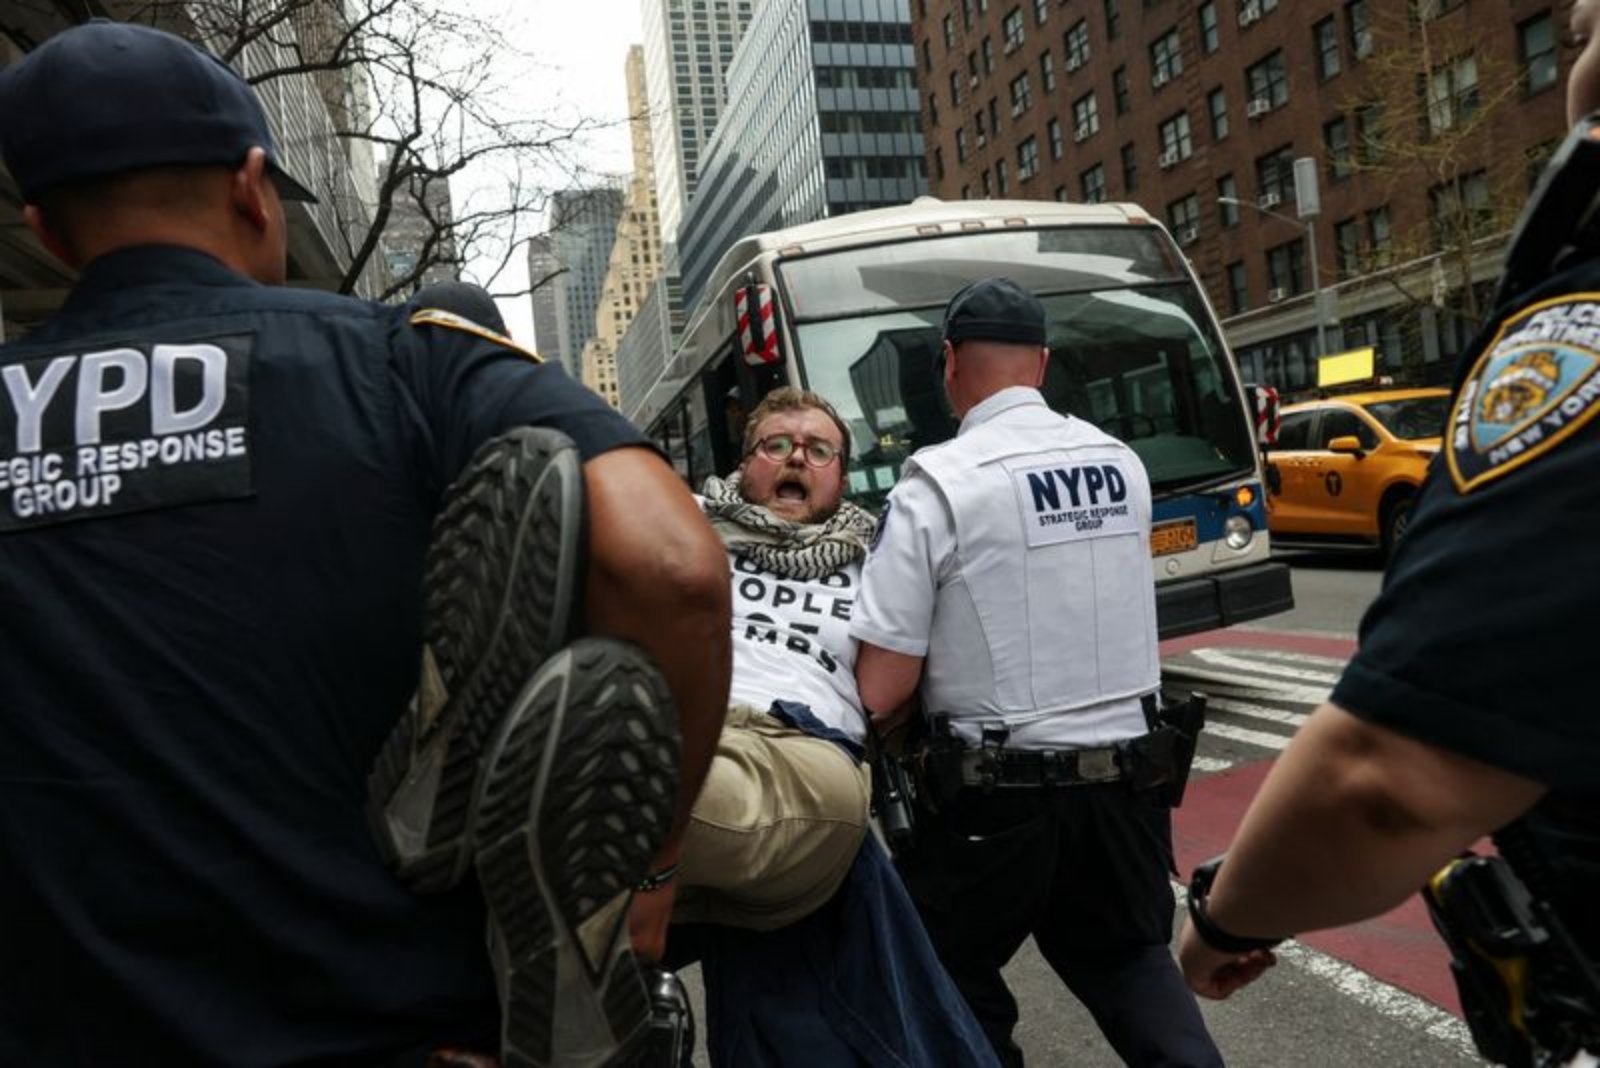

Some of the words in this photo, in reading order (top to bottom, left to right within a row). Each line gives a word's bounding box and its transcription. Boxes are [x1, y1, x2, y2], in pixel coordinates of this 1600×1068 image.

[1, 343, 228, 453] YPD
[77, 426, 246, 477] RESPONSE
[1489, 424, 1543, 465] NEW
[13, 474, 121, 518] GROUP
[1026, 464, 1127, 513] NYPD
[1039, 510, 1089, 527] STRATEGIC
[1090, 504, 1129, 519] RESPONSE
[1075, 519, 1104, 532] GROUP
[739, 576, 854, 622] OPLE
